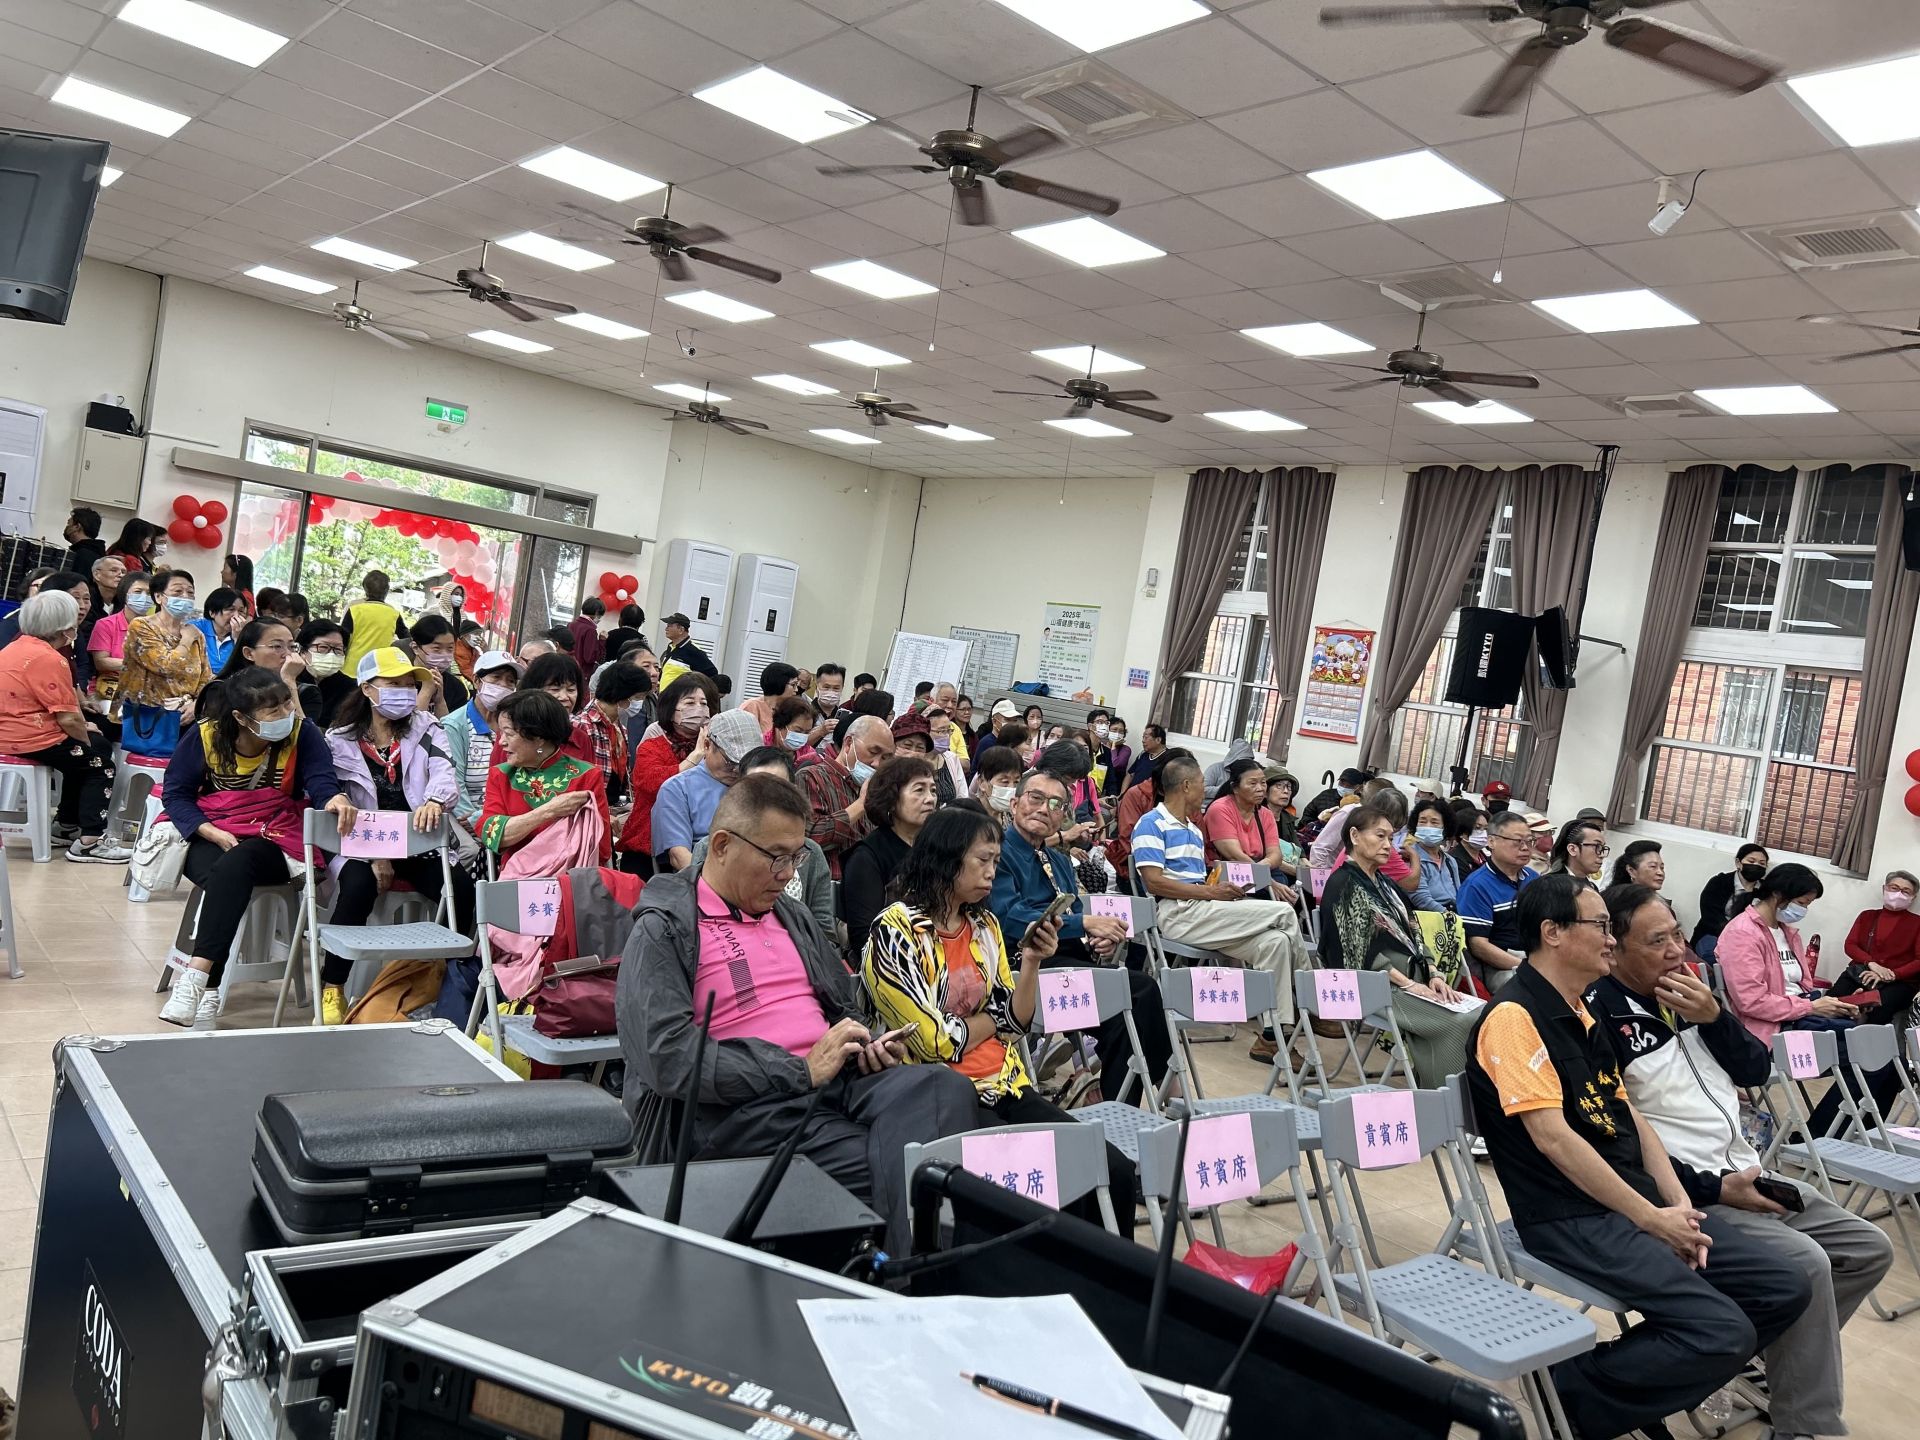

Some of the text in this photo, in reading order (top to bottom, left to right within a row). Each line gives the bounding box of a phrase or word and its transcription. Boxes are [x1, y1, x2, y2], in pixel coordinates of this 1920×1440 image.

[1062, 610, 1081, 619] 2025年
[363, 812, 376, 823] 21
[350, 829, 400, 842] 參賽者席
[1105, 898, 1114, 907] 15
[1062, 974, 1070, 989] 3
[1211, 970, 1223, 983] 4
[1332, 972, 1339, 982] 5
[1048, 992, 1091, 1012] 參賽者席
[1199, 988, 1240, 1004] 參賽者席
[1321, 988, 1355, 1003] 參賽者席
[1364, 1120, 1409, 1148] 貴賓席
[1195, 1153, 1247, 1190] 貴賓席
[85, 1284, 122, 1410] CODA
[648, 1359, 731, 1398] KYYO
